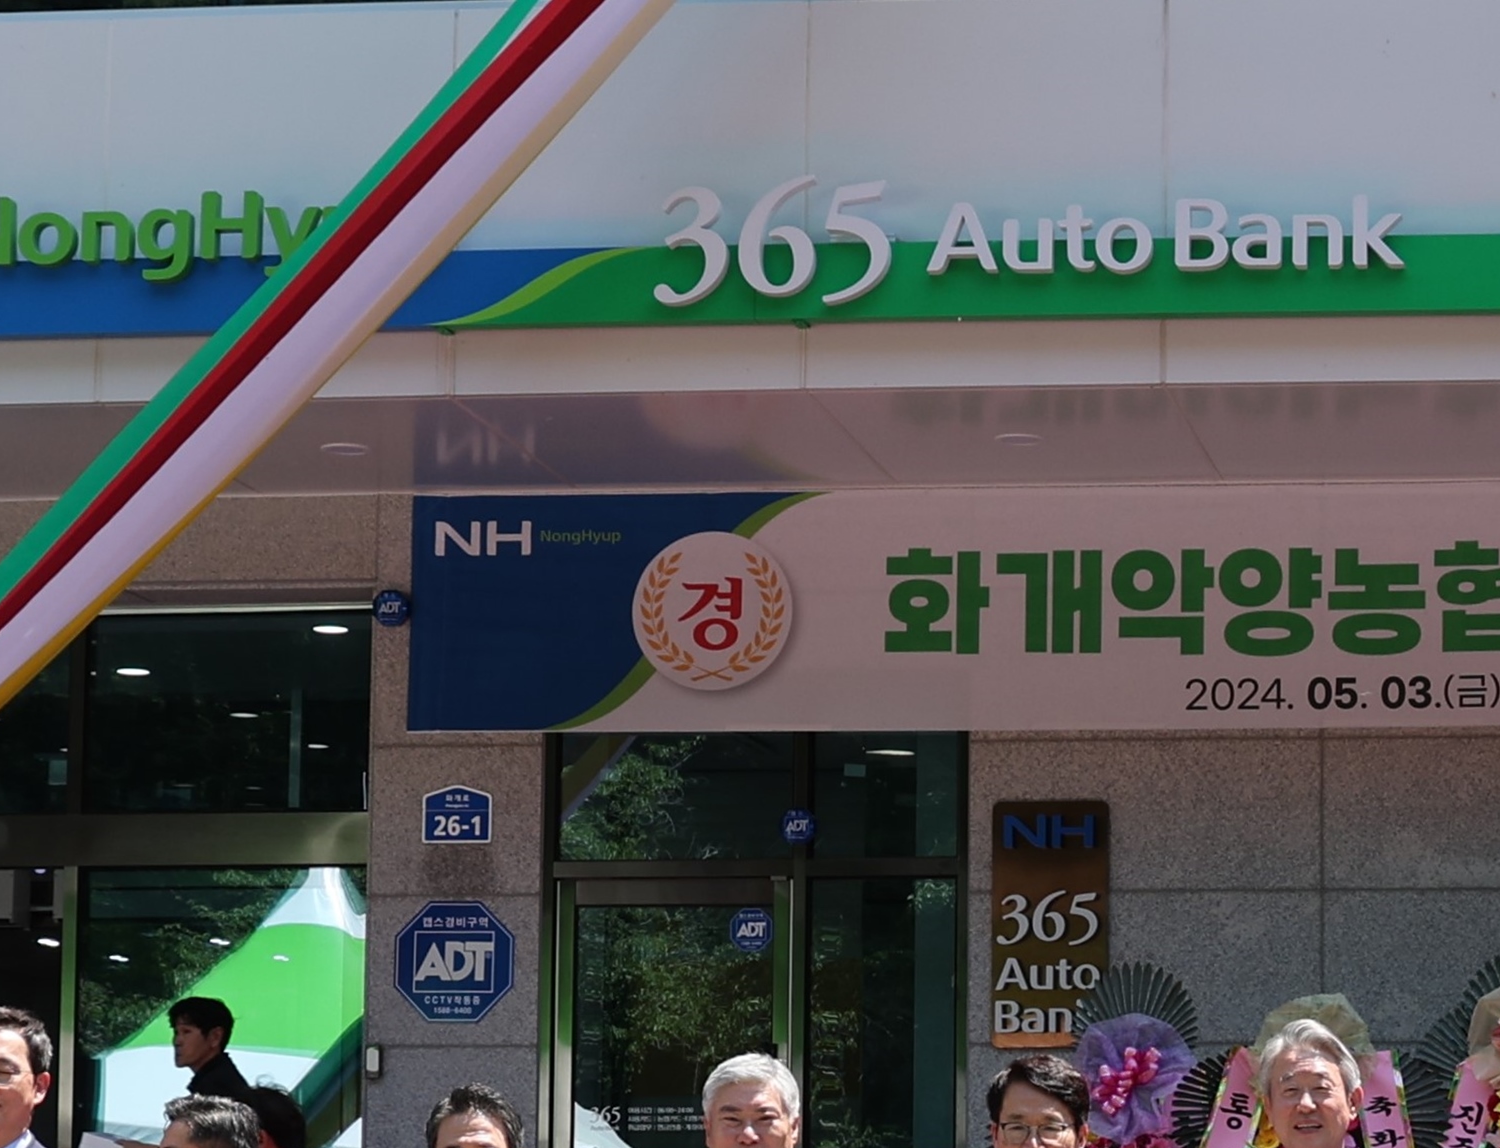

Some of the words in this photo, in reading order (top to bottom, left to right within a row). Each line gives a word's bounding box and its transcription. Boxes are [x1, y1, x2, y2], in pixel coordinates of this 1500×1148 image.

[652, 175, 894, 308] 365
[927, 201, 1154, 277] Auto
[1173, 196, 1406, 275] Bank
[434, 520, 532, 556] NH
[539, 530, 622, 545] NongHyup
[378, 600, 401, 614] ADT
[678, 577, 743, 652] 경
[1185, 676, 1294, 711] 2024.
[1307, 676, 1368, 710] 05.
[433, 815, 481, 836] 26-1
[785, 819, 810, 833] ADT
[1003, 814, 1095, 848] NH
[422, 916, 489, 929] 캡스경비구역
[736, 921, 767, 938] ADT
[996, 890, 1099, 946] 365
[414, 940, 495, 982] ADT
[995, 957, 1100, 990] Auto
[994, 999, 1082, 1033] Ban
[590, 1105, 621, 1124] 365
